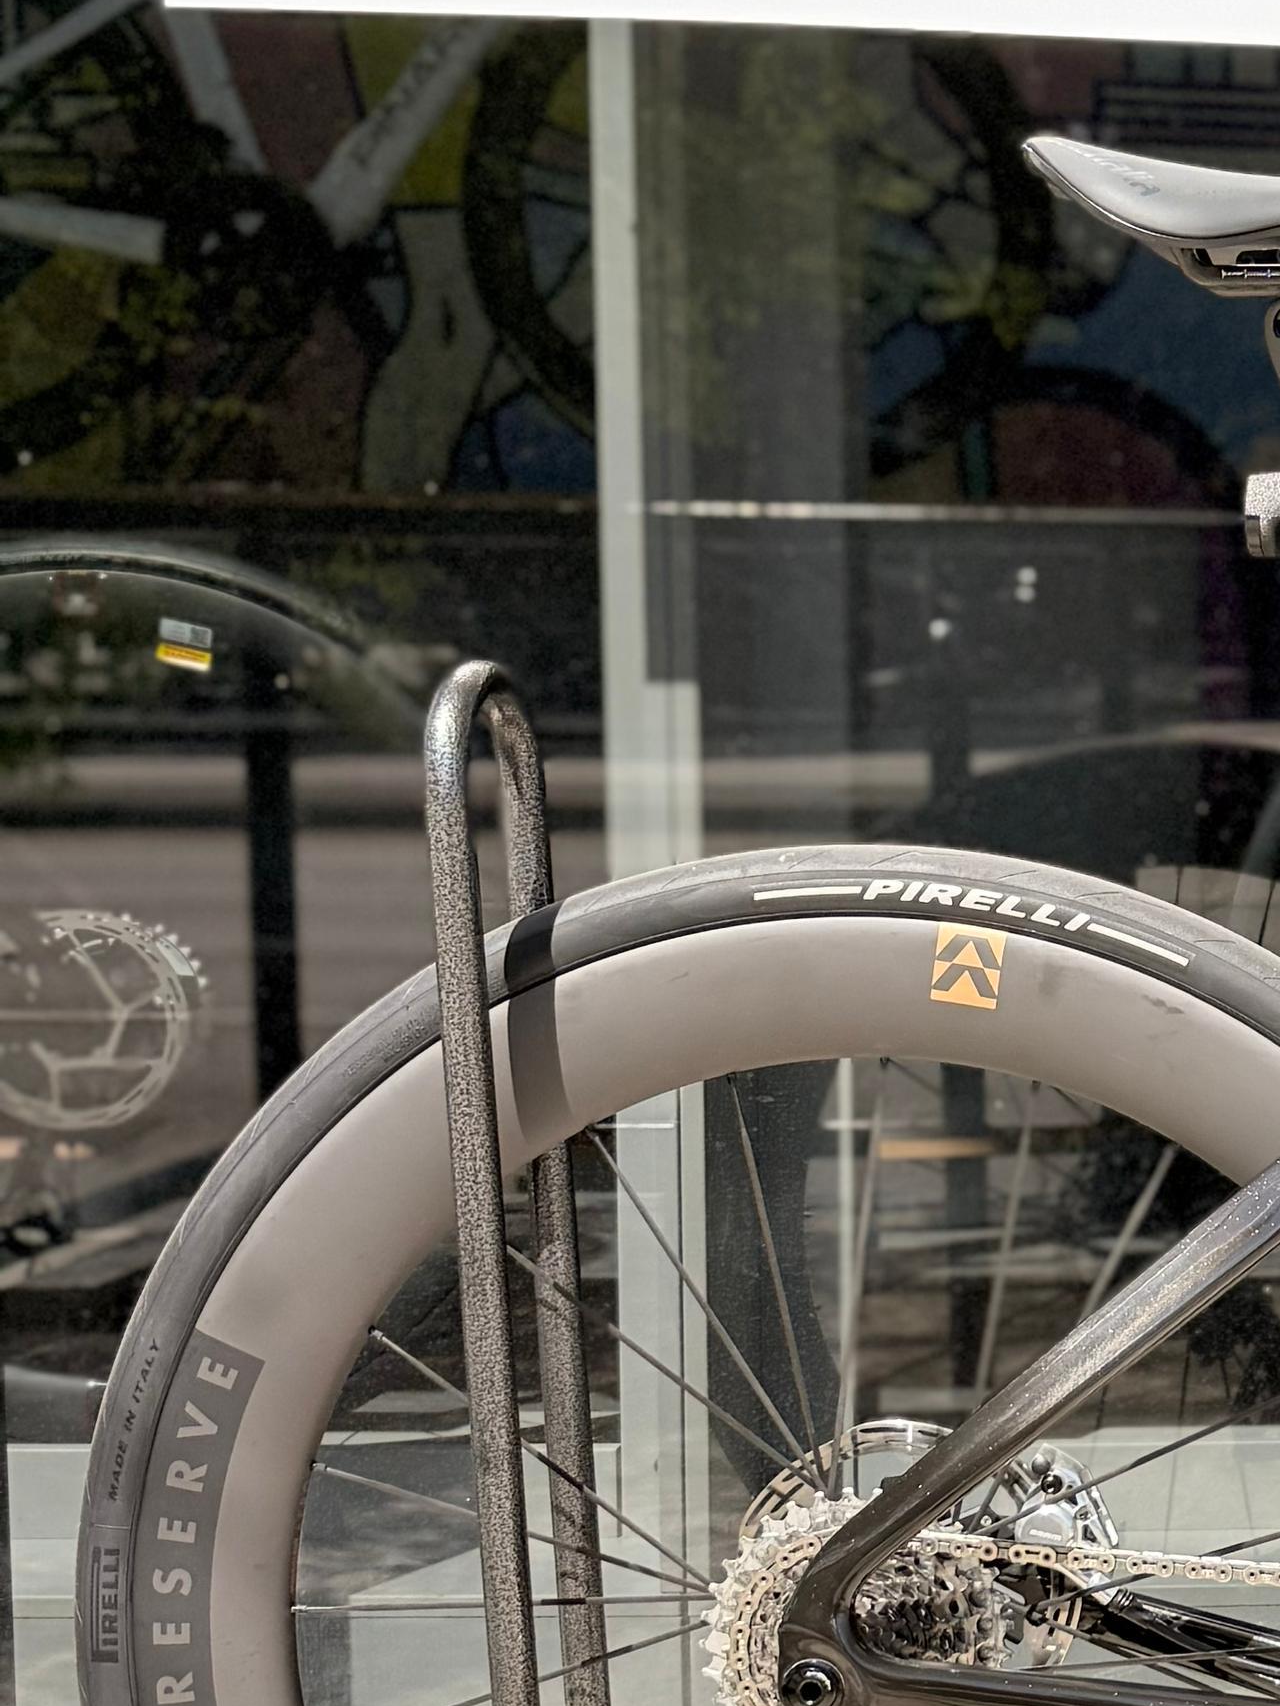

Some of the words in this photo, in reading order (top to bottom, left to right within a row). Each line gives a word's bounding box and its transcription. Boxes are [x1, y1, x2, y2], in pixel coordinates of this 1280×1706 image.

[862, 879, 1091, 932] PIRELLI
[109, 1440, 129, 1502] MADE
[123, 1412, 138, 1434] IN
[132, 1337, 160, 1404] ITALY
[152, 1356, 240, 1705] RESERVE
[90, 1546, 121, 1663] PIRELLI
